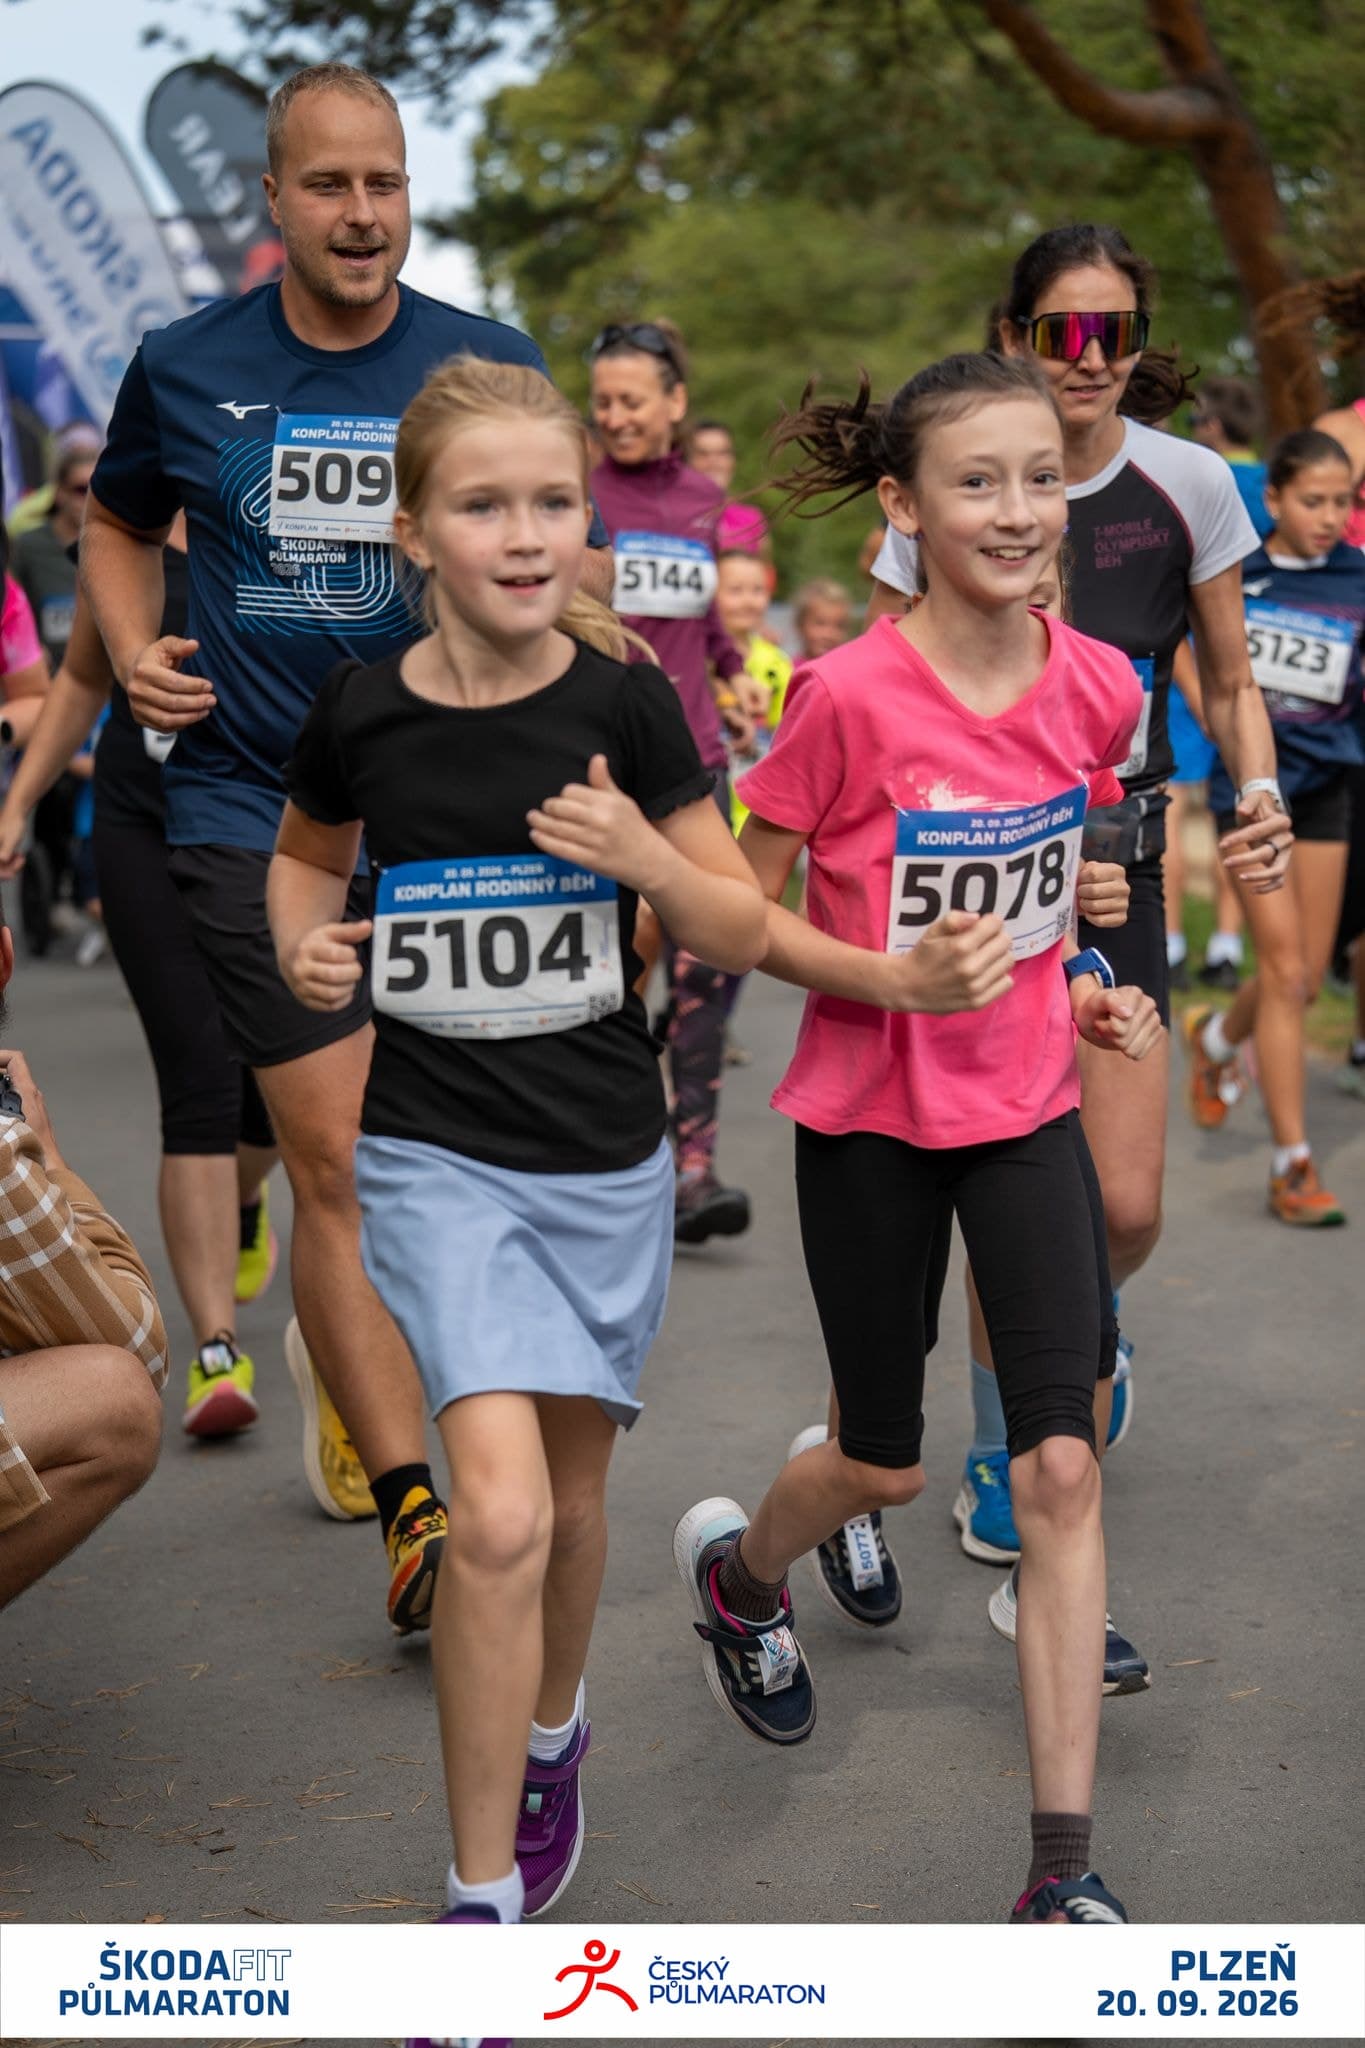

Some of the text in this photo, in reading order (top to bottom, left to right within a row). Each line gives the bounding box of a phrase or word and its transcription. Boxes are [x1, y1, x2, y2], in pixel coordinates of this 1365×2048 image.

[291, 428, 399, 444] KONPLAN RODINN
[277, 451, 393, 507] 509
[284, 523, 319, 533] KONPLAN
[623, 560, 703, 594] 5144
[1248, 629, 1330, 674] 5123
[916, 806, 1074, 846] KONPLAN RODINNÝ BĚH
[394, 873, 595, 902] KONPLAN RODINNÝ BĚH
[897, 840, 1066, 927] 5078
[386, 911, 592, 992] 5104
[854, 1531, 875, 1571] 5077
